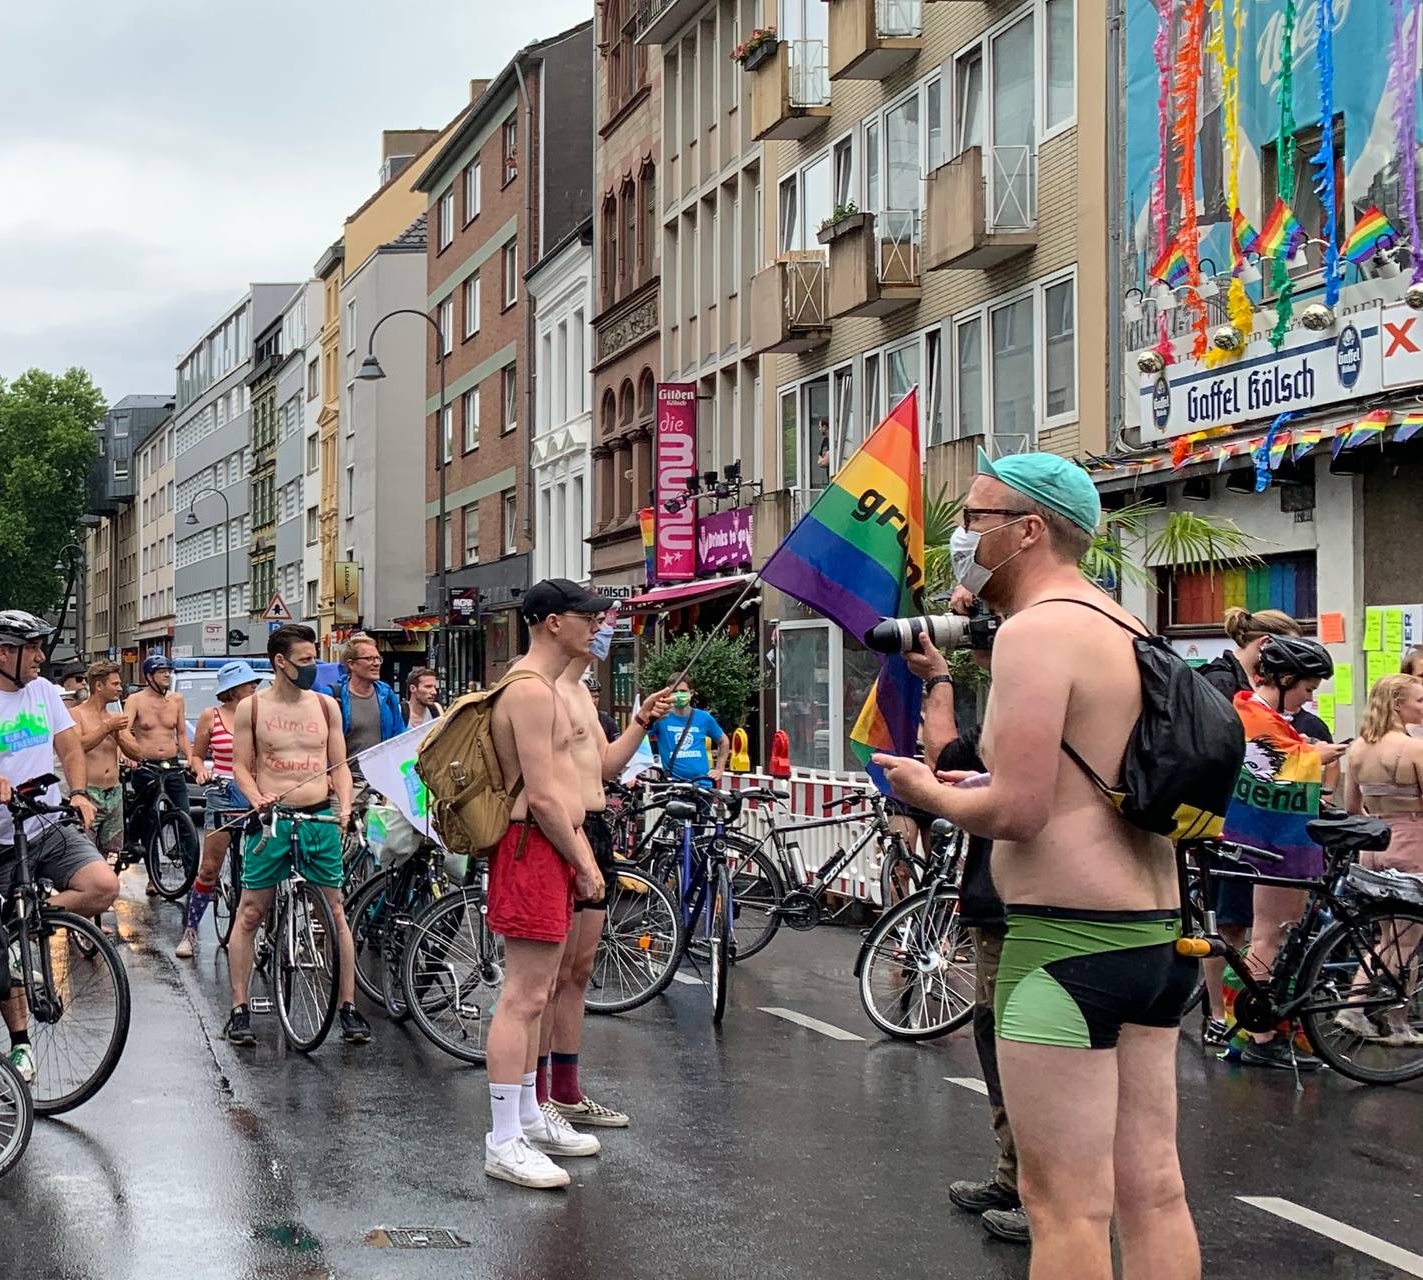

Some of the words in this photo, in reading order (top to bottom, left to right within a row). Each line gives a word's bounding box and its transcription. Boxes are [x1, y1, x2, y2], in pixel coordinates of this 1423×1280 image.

[658, 389, 695, 400] Gilden
[1187, 375, 1241, 423] Gaffel
[1247, 357, 1316, 413] Kölsch
[659, 411, 684, 432] die
[265, 716, 320, 734] Klima
